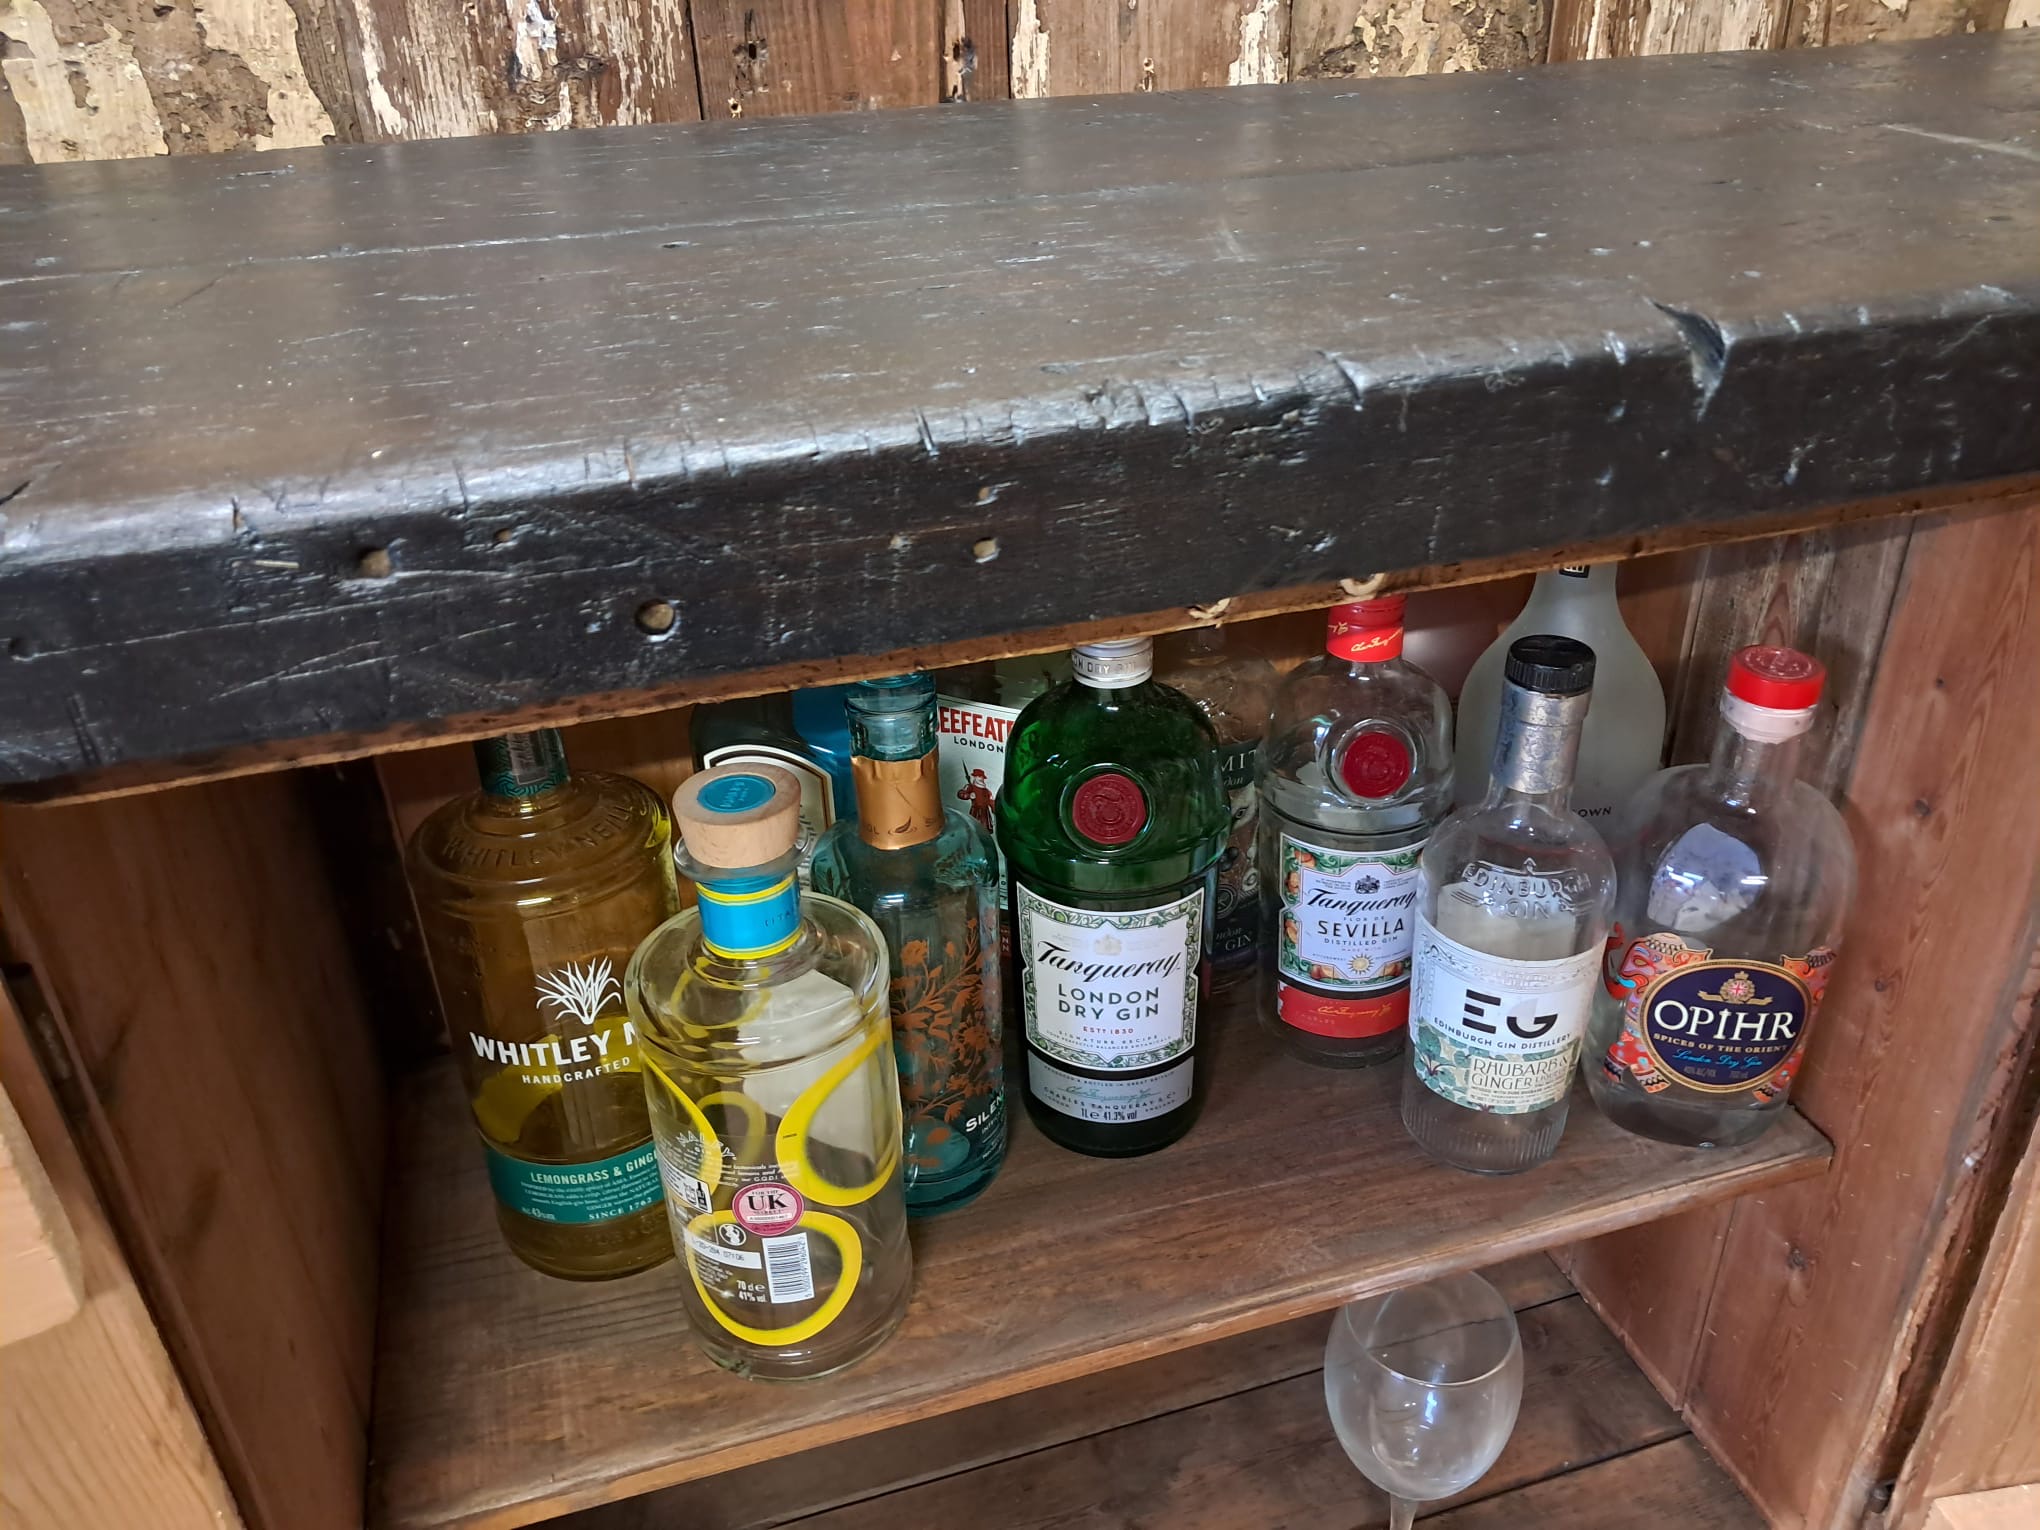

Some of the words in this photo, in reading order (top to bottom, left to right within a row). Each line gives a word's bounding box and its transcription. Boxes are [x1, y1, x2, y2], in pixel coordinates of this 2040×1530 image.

[953, 736, 1004, 753] LONDON
[1307, 887, 1417, 916] Tanqueray
[1317, 917, 1404, 938] SEVILLA
[1324, 937, 1377, 946] DISTILLED
[1037, 940, 1182, 983] Tanqueray
[1058, 983, 1160, 1005] LONDON
[1058, 1003, 1105, 1021] DRY
[1116, 1003, 1160, 1021] GIN
[1653, 999, 1797, 1042] OPIHR
[1110, 1027, 1134, 1035] 1830
[1434, 1016, 1492, 1047] EDINBURGH
[1496, 1040, 1517, 1050] GIN
[1521, 1032, 1572, 1050] DISTILLERY
[469, 1029, 611, 1067] WHITLEY
[1653, 1032, 1695, 1048] SPICES
[1698, 1042, 1714, 1051] OF
[1718, 1045, 1742, 1053] THE
[1744, 1044, 1788, 1054] ORIENT
[522, 1056, 631, 1084] HANDCRAFTED
[1473, 1057, 1557, 1077] RHUBARB
[1471, 1072, 1532, 1090] GINGER
[1091, 1098, 1154, 1110] TANQUERAY
[1103, 1111, 1126, 1121] 41.3%
[1127, 1110, 1138, 1120] vol
[530, 1169, 610, 1185] LEMONGRASS
[613, 1166, 622, 1177] &
[747, 1192, 789, 1211] UK
[588, 1207, 625, 1221] SINCE
[736, 1279, 747, 1291] 70
